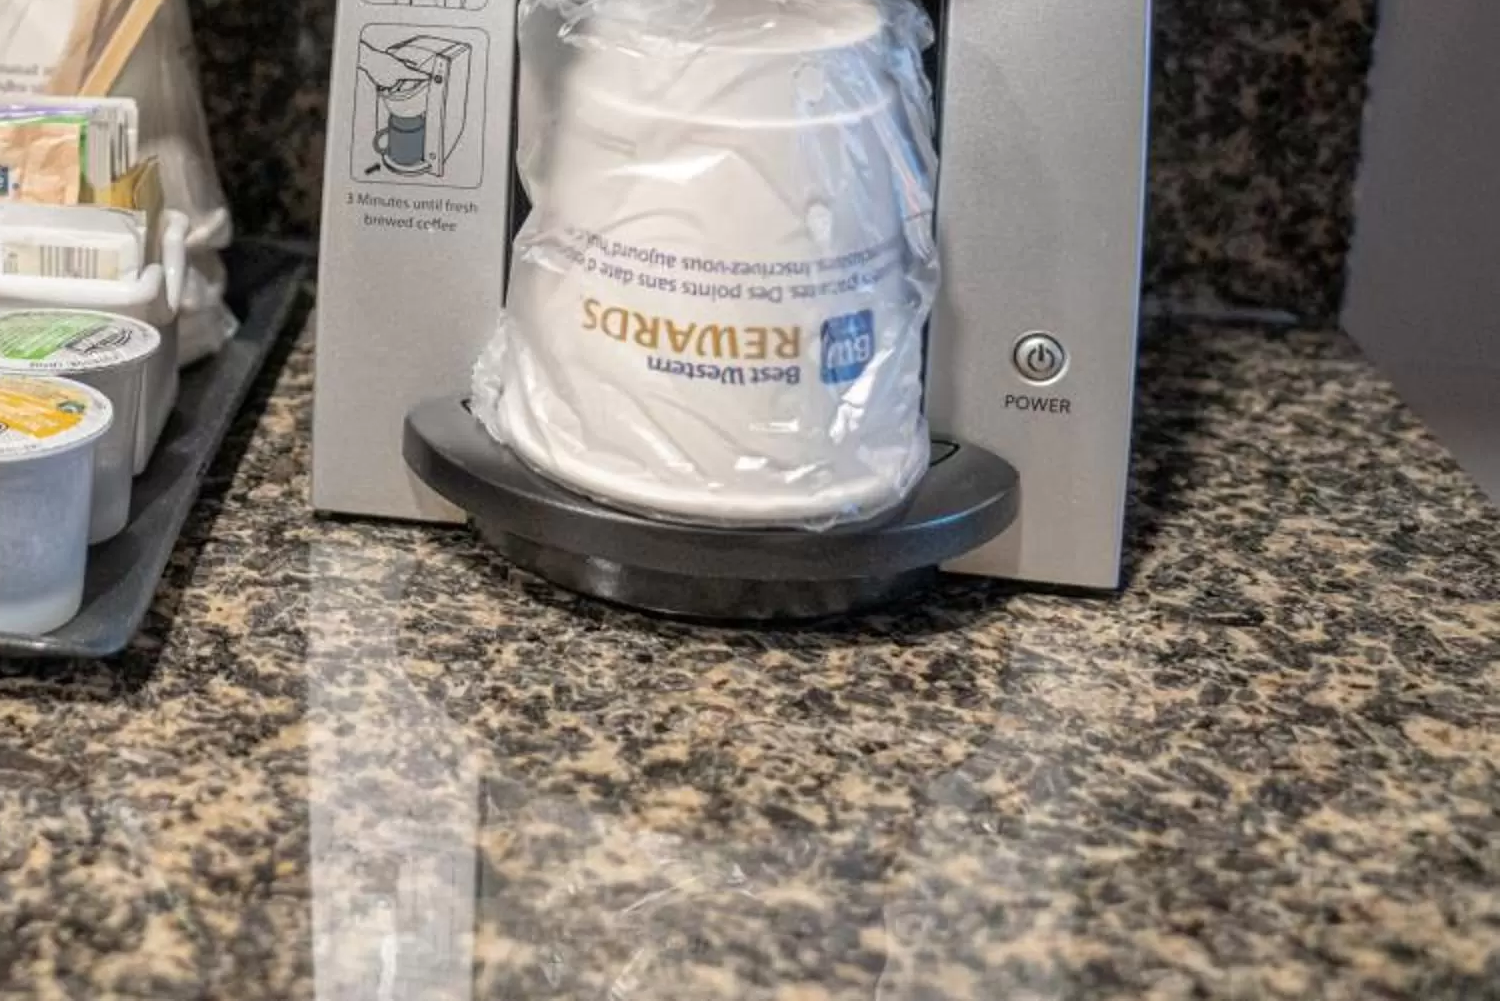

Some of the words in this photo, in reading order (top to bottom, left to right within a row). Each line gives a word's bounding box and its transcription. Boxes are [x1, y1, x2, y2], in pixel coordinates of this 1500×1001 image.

[413, 198, 443, 212] until
[446, 198, 479, 214] fresh
[363, 212, 413, 228] brewed
[416, 217, 457, 232] coffee
[598, 262, 634, 286] date
[638, 272, 677, 293] sans
[682, 280, 742, 302] points
[749, 285, 783, 303] Des
[582, 298, 801, 361] REWARDS
[646, 355, 746, 386] Western
[750, 365, 801, 386] Best
[1004, 394, 1072, 414] POWER
